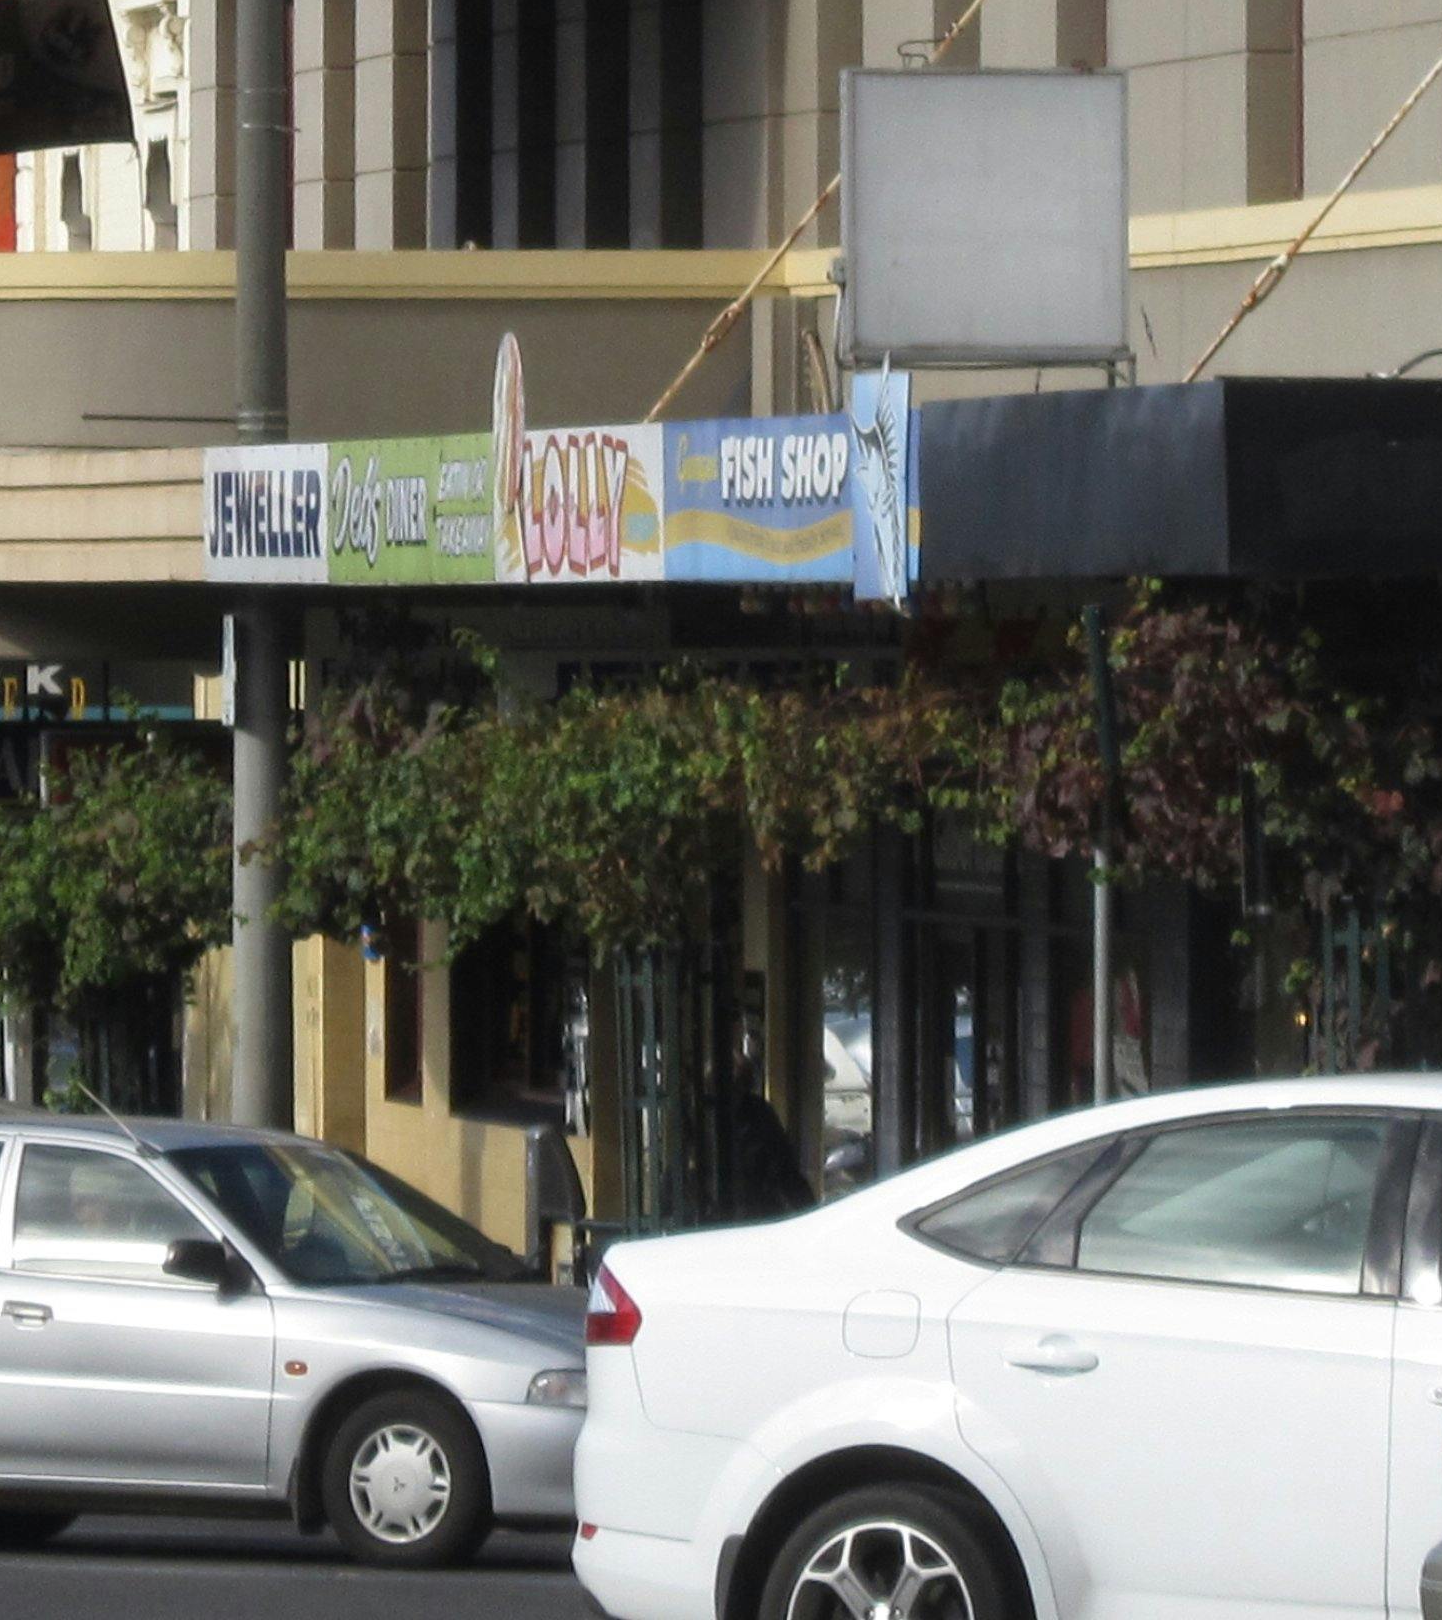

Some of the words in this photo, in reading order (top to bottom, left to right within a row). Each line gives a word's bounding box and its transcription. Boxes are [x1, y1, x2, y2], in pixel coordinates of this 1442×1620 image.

[522, 433, 628, 578] LOLLY
[721, 436, 775, 502] FISH
[781, 433, 849, 501] SHOP
[209, 469, 322, 558] JEWELLER
[386, 476, 428, 544] DINER
